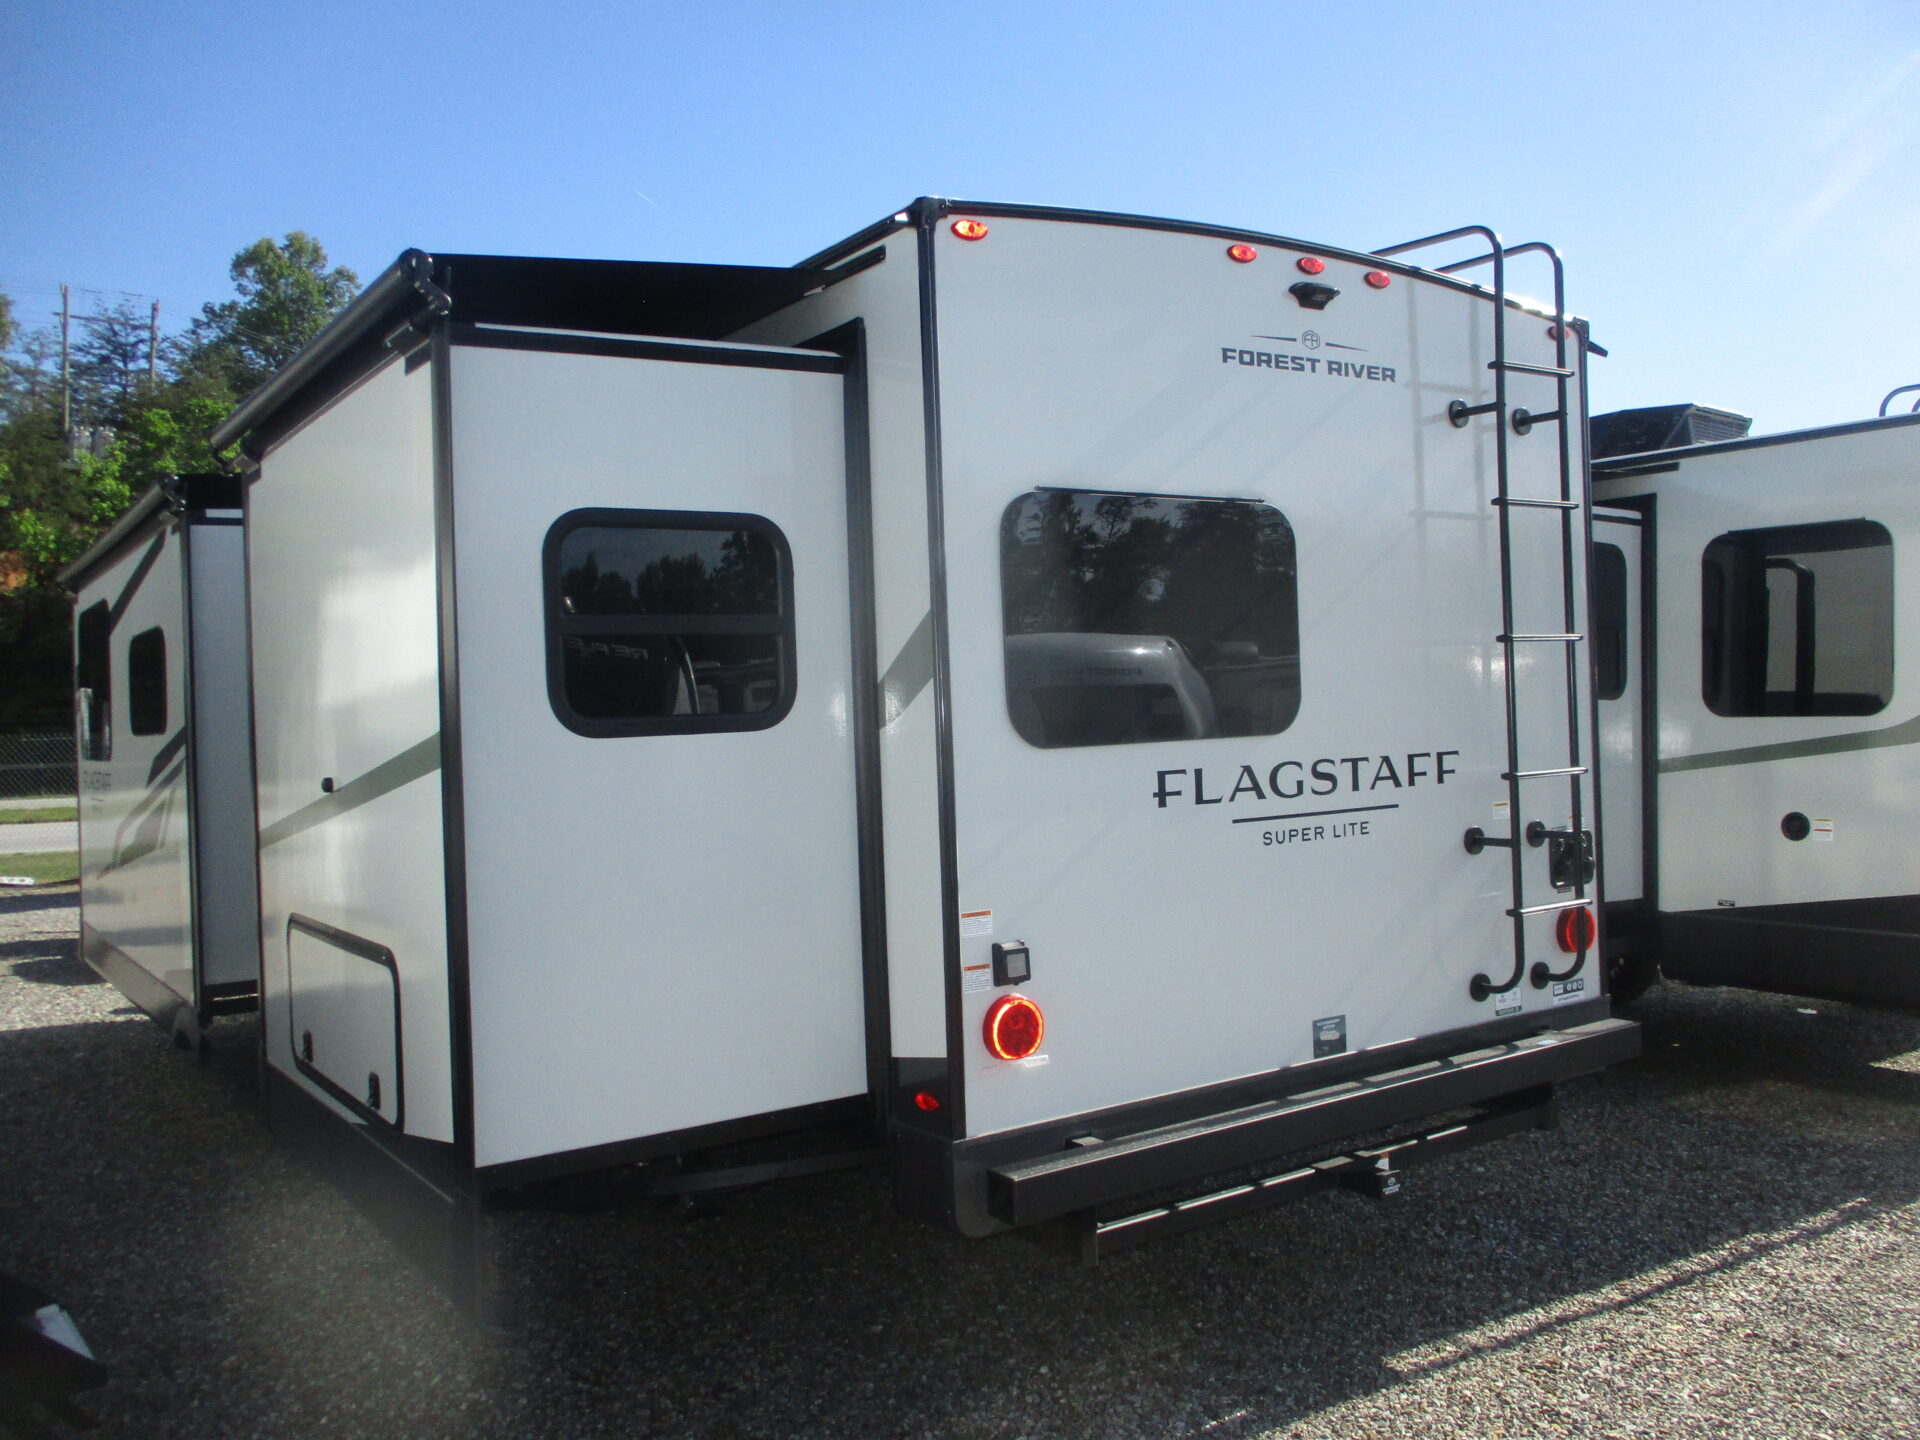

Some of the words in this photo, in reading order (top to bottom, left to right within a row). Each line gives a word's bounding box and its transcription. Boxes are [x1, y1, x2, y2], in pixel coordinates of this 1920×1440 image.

[1221, 347, 1321, 373] FOREST
[1326, 359, 1396, 383] RIVER
[1152, 750, 1460, 808] FLAGSTAFF
[1263, 826, 1325, 846] SUPER
[1332, 821, 1370, 838] LITE
